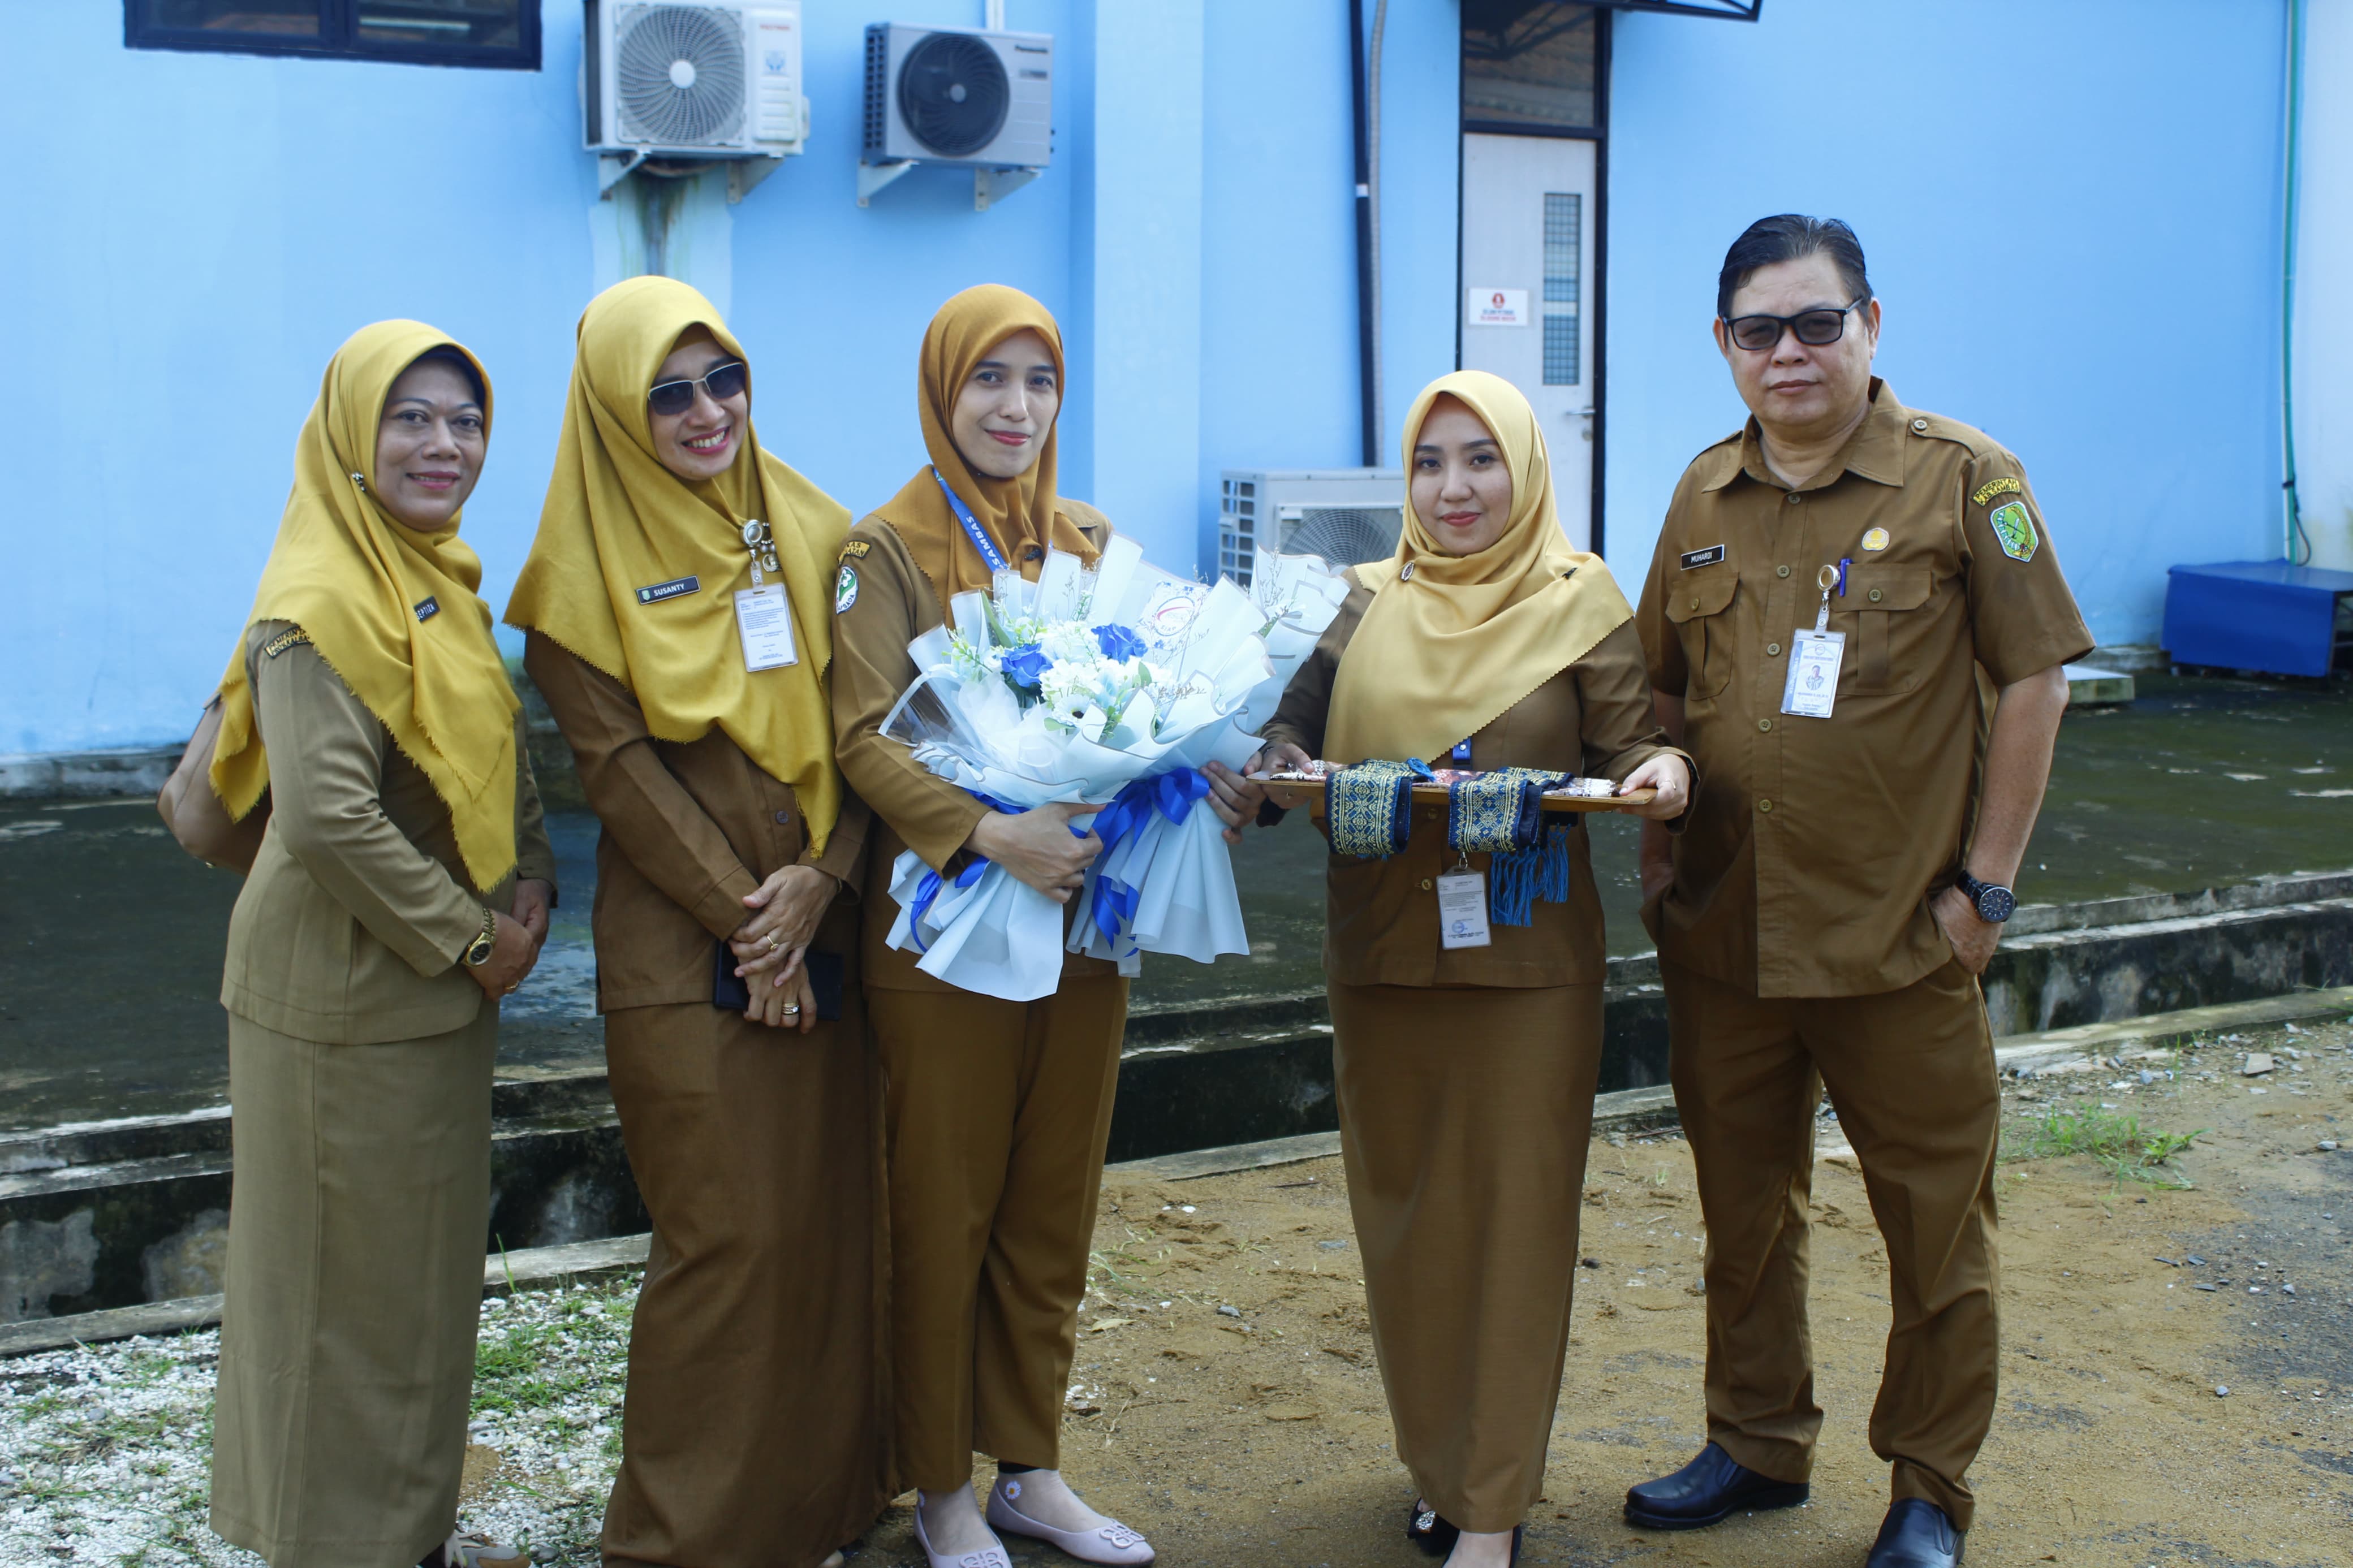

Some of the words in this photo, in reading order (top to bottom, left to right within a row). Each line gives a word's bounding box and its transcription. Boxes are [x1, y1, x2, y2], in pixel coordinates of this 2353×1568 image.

[966, 515, 1001, 566] SAMBAS
[1691, 551, 1713, 564] MUHARDI
[653, 583, 685, 597] SUSANTY
